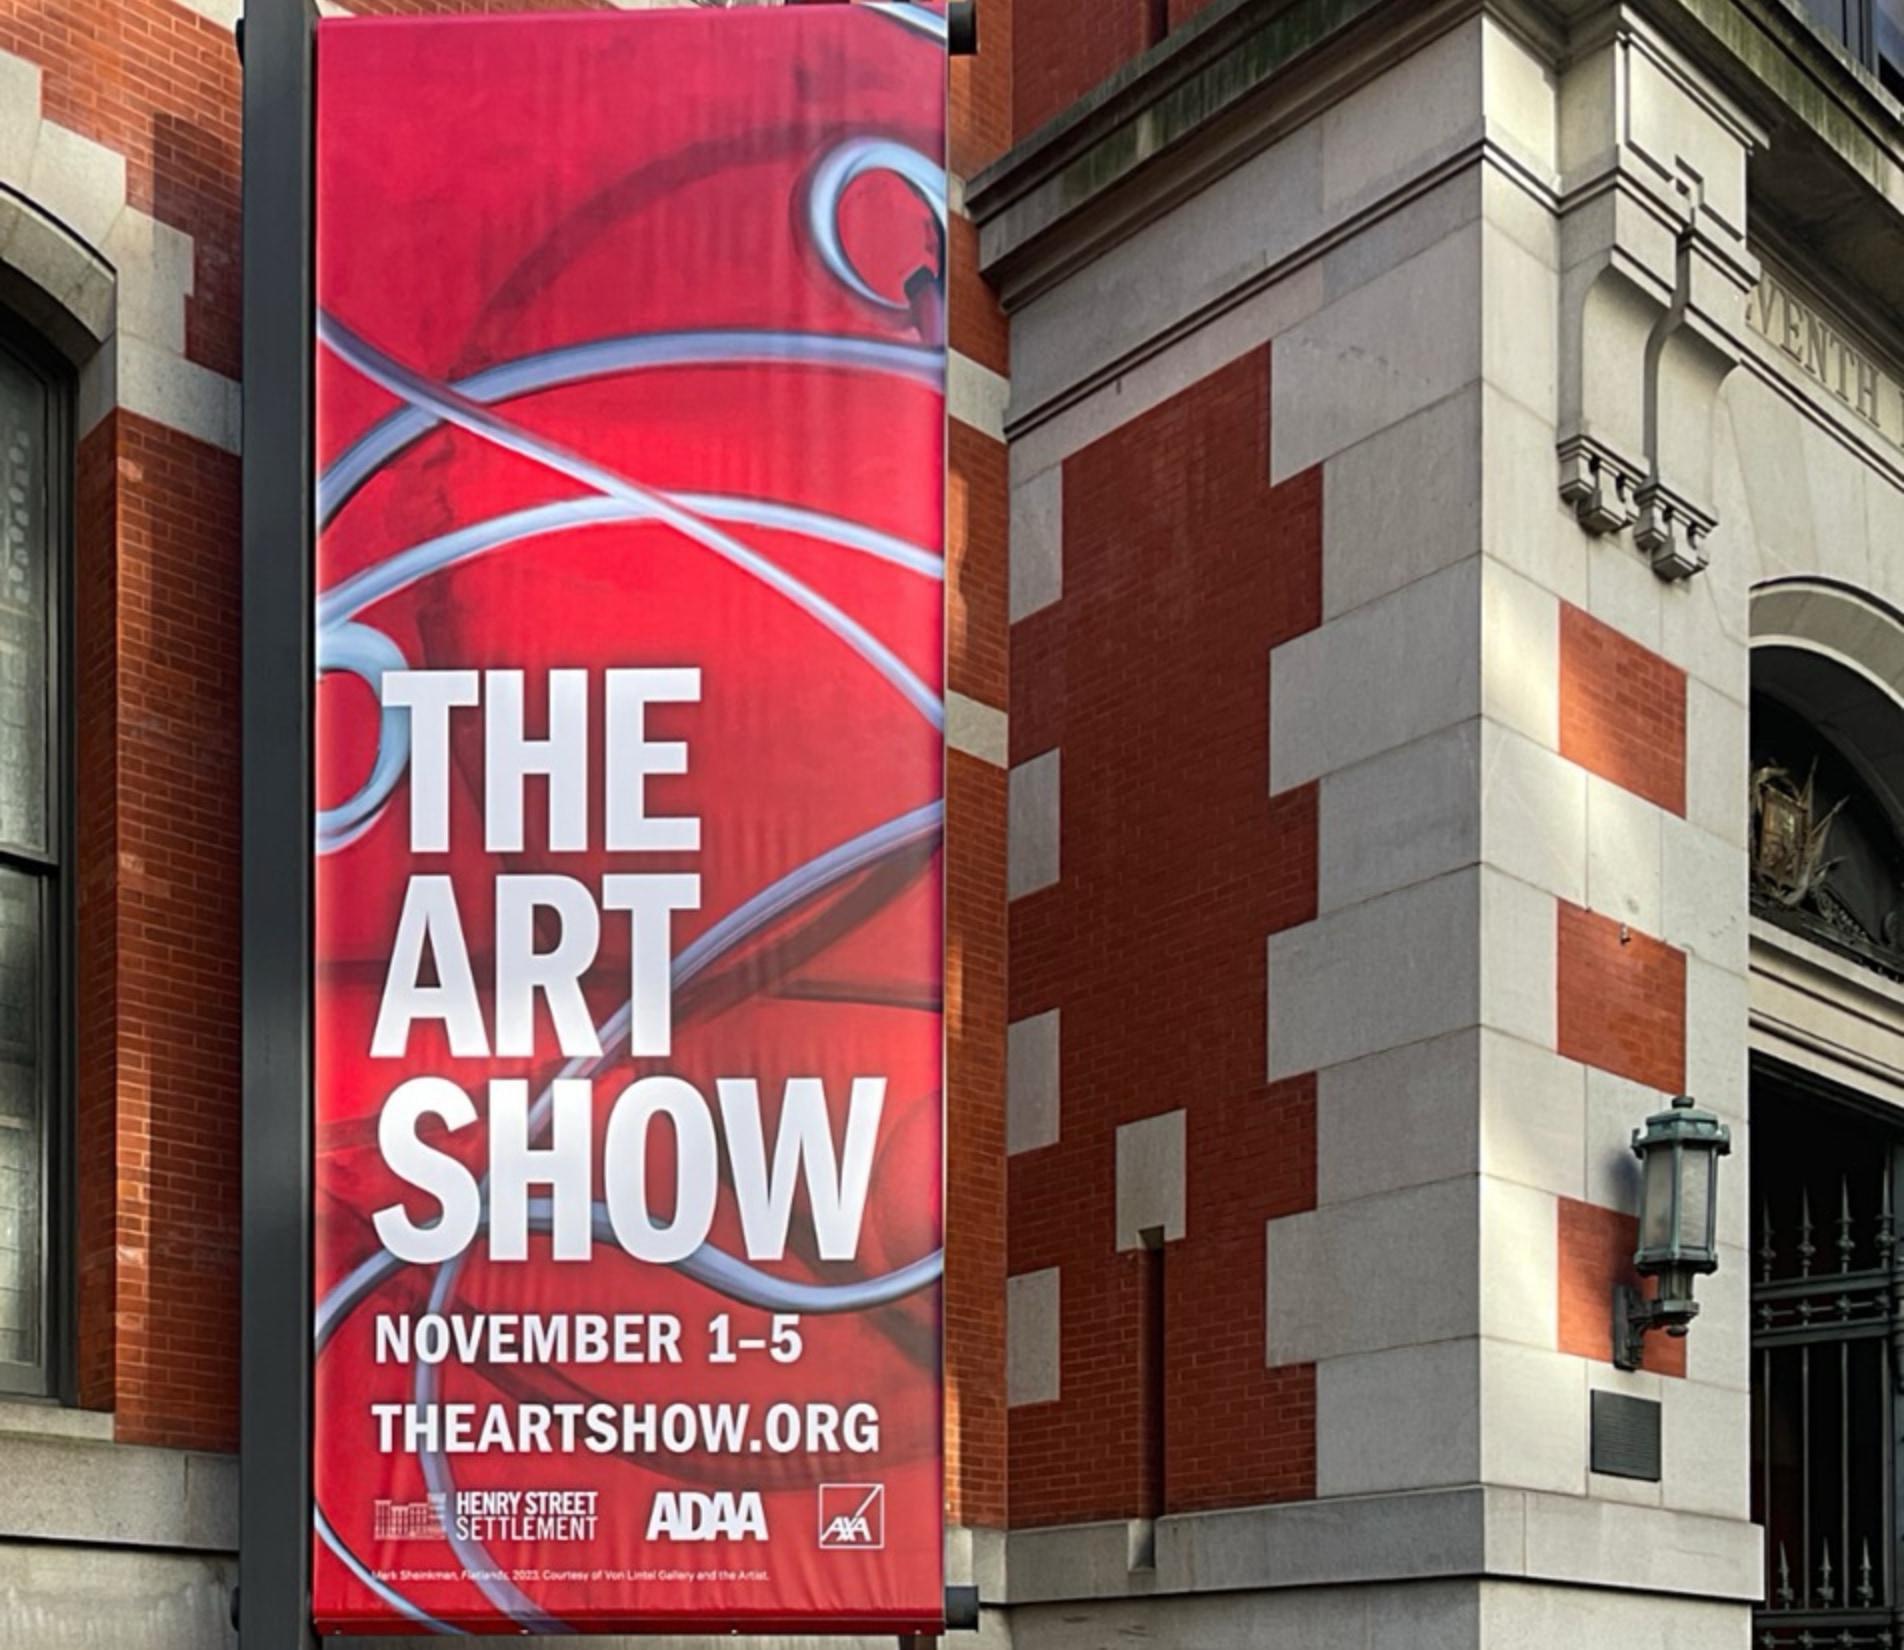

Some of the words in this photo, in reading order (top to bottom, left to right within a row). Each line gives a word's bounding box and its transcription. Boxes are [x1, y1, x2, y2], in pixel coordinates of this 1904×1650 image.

[381, 667, 701, 853] THE
[369, 873, 701, 1058] ART
[371, 1075, 888, 1264] SHOW
[374, 1313, 683, 1364] NOVEMBER
[371, 1403, 880, 1453] THEARTSHOW.ORG
[456, 1491, 521, 1515] HENRY
[525, 1491, 598, 1515] STREET
[645, 1491, 769, 1541] ADAA
[456, 1516, 598, 1541] SETTLEMENT
[542, 1570, 589, 1583] Courtesy
[591, 1570, 602, 1582] of
[604, 1570, 624, 1582] Von
[658, 1570, 693, 1583] Gallery
[696, 1570, 716, 1582] and
[718, 1570, 736, 1582] the
